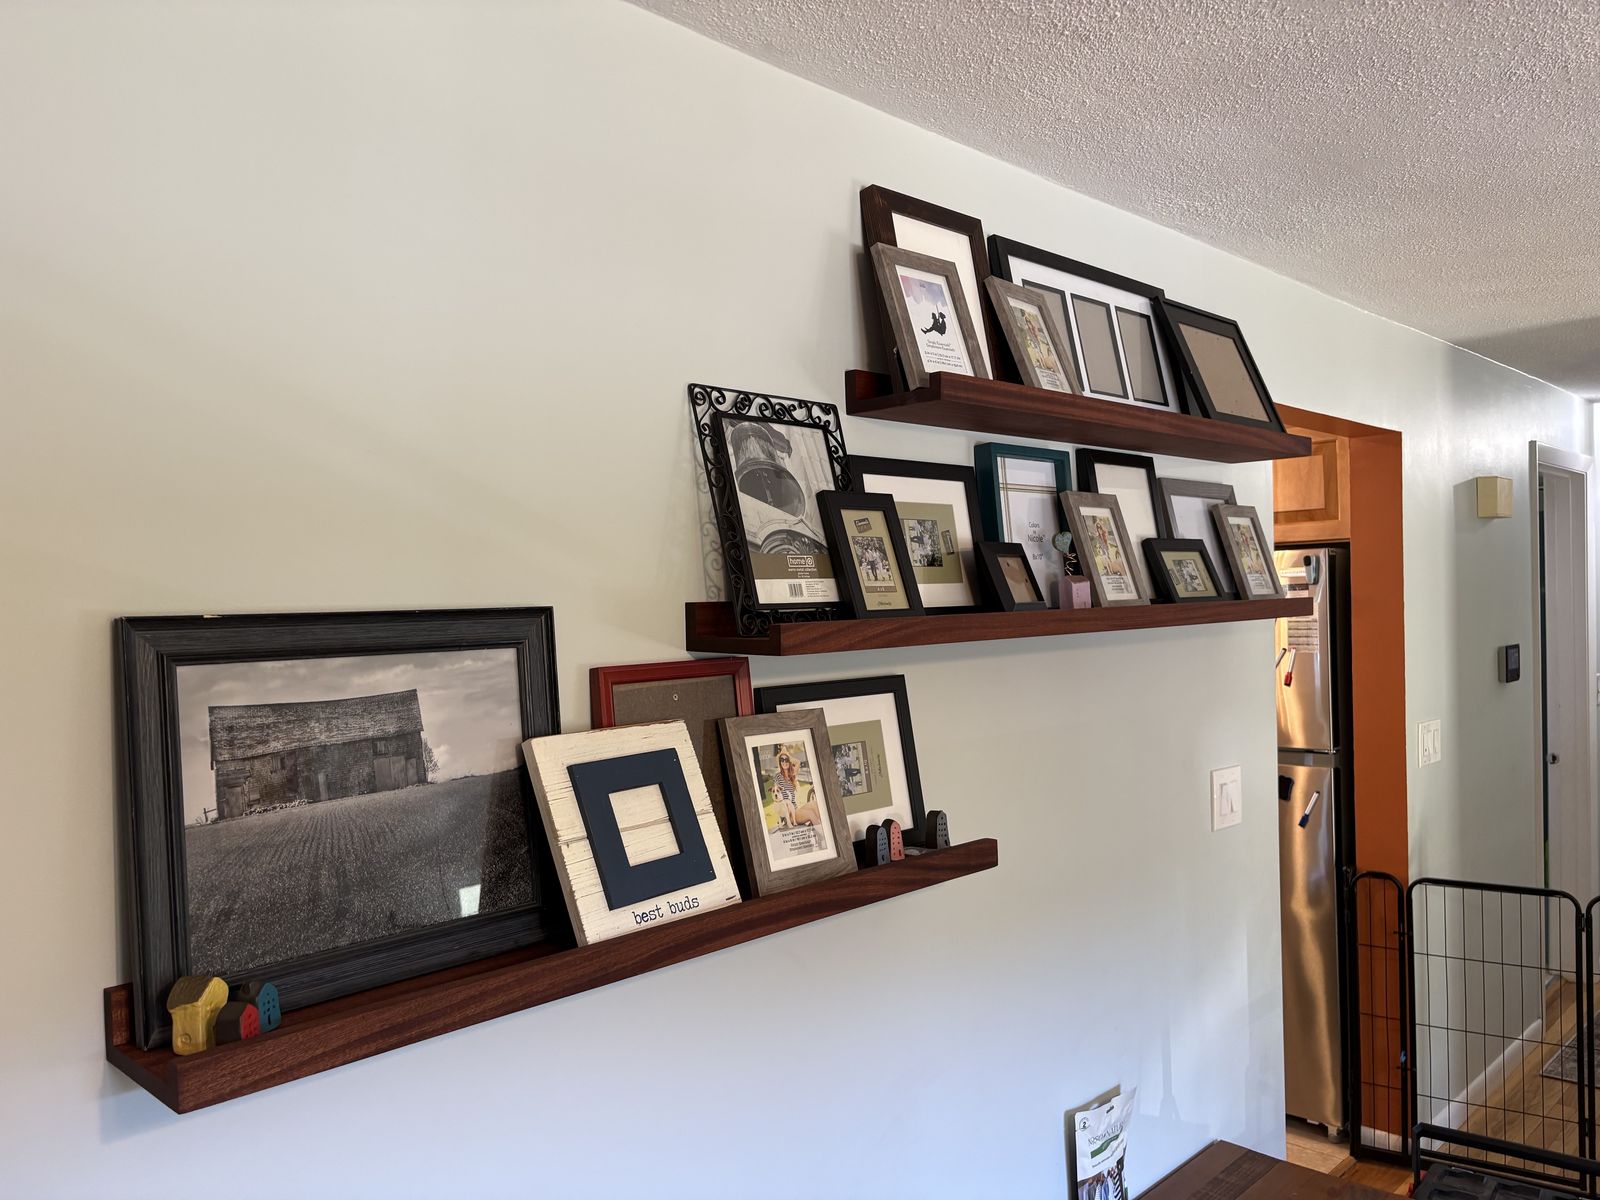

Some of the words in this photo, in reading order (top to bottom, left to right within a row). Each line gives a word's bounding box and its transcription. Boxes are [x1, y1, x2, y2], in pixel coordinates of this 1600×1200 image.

[789, 557, 806, 565] home
[632, 904, 664, 925] best
[667, 895, 700, 914] buds
[1082, 1121, 1087, 1129] 2
